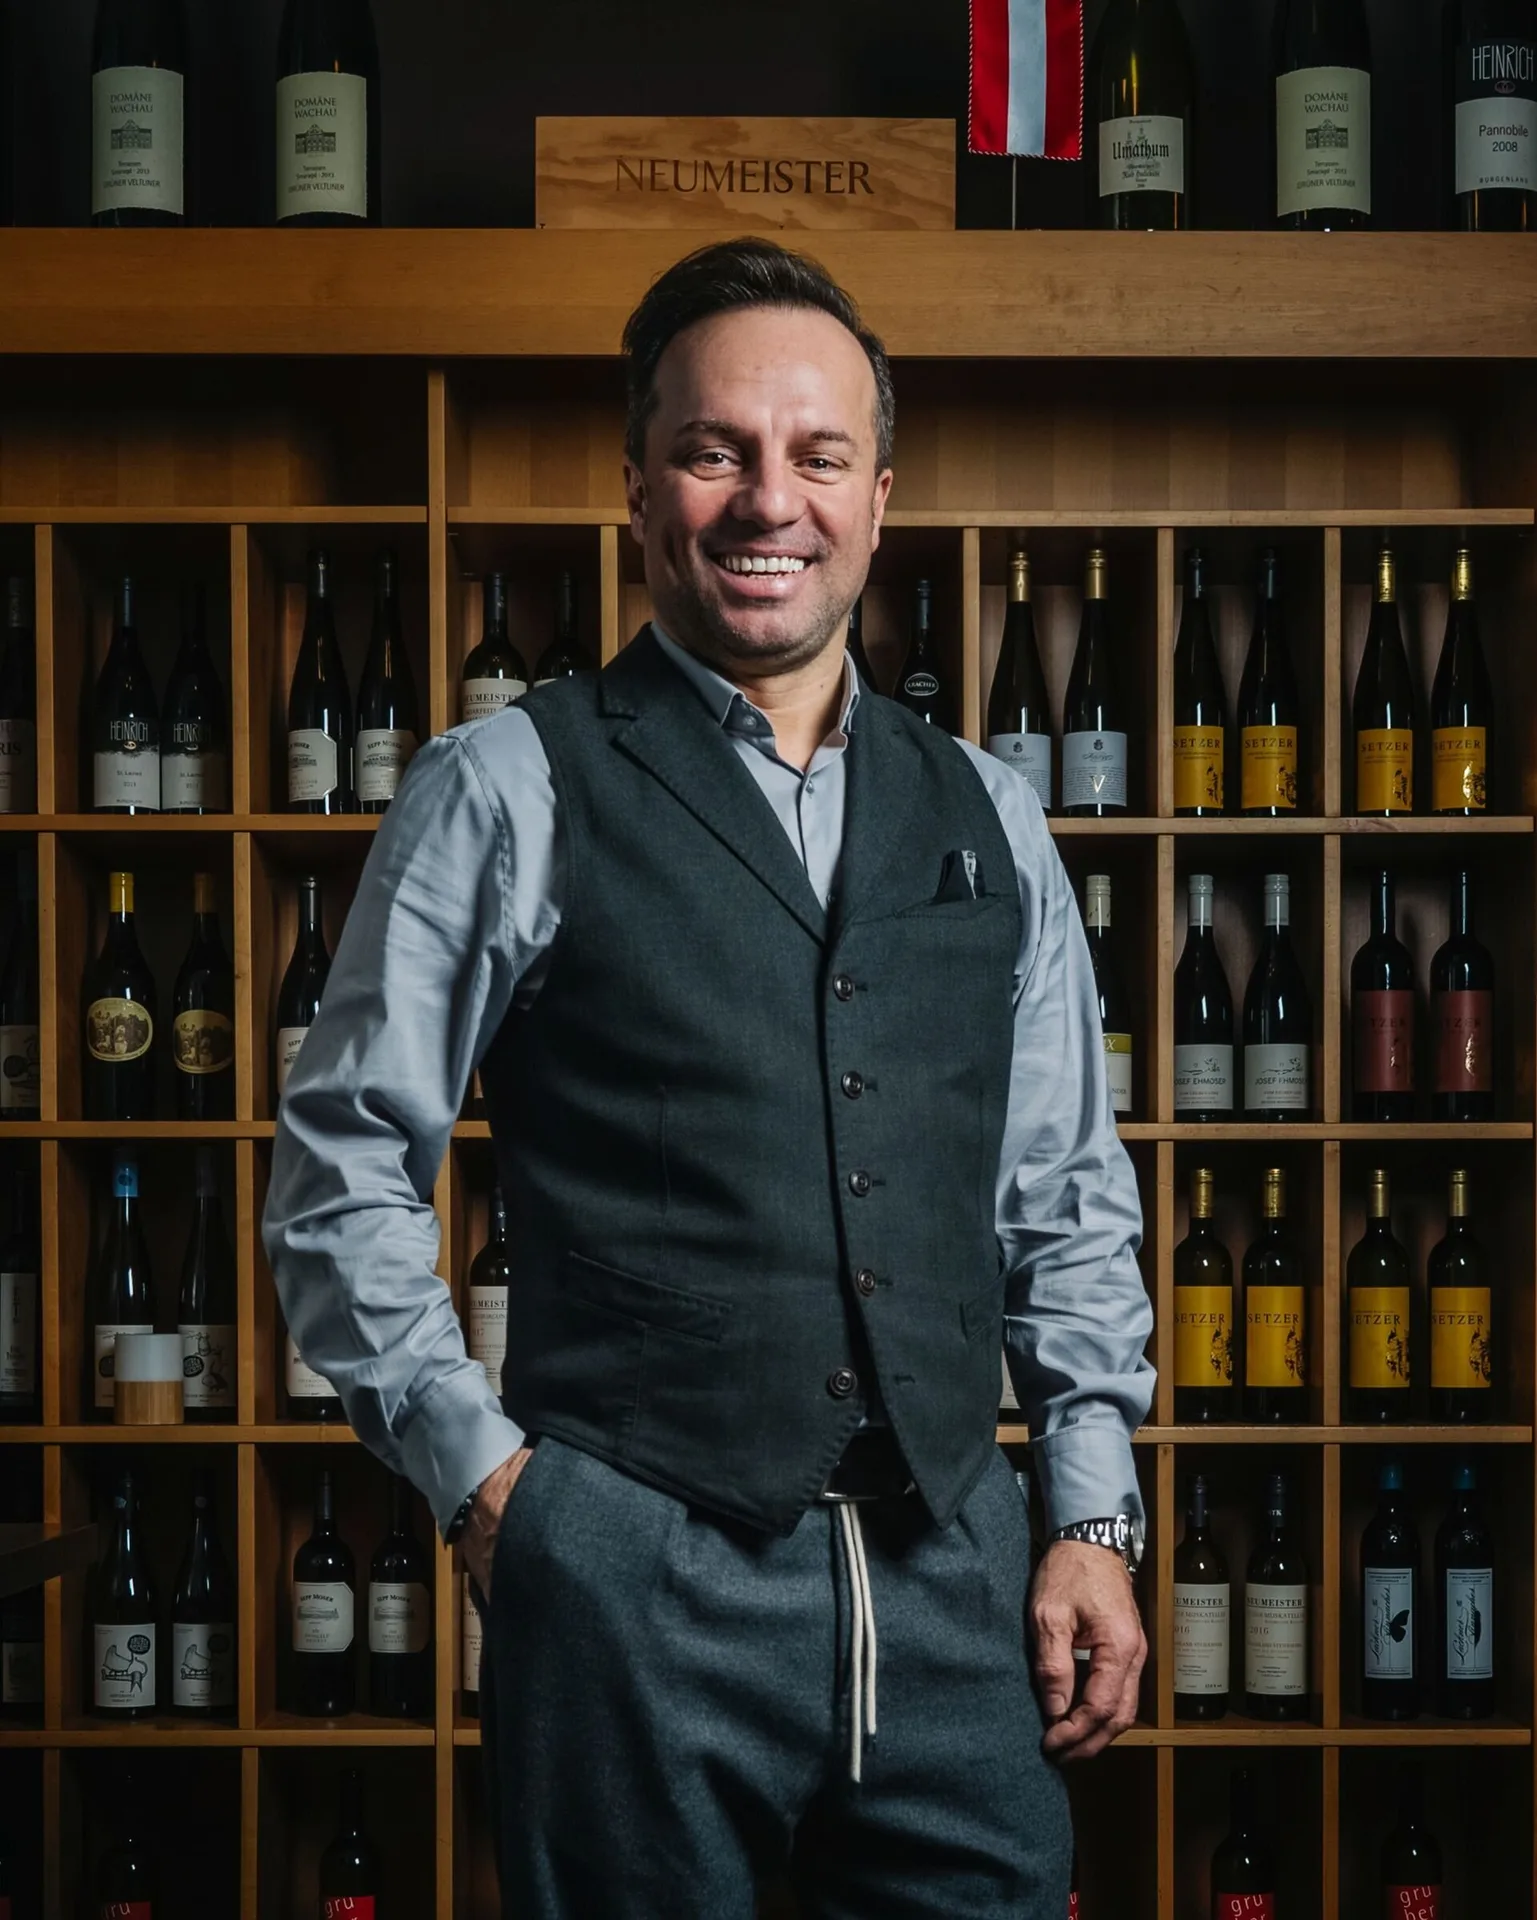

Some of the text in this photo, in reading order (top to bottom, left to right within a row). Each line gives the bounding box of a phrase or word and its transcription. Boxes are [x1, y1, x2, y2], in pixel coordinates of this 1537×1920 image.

[1472, 45, 1534, 81] HEINRICH
[110, 91, 153, 103] DOMÄNE
[294, 95, 337, 108] DOMÄNE
[1304, 91, 1349, 103] DOMÄNE
[110, 103, 154, 114] WACHAU
[294, 108, 337, 119] WACHAU
[1304, 103, 1349, 113] WACHAU
[1478, 124, 1529, 137] Pannobile
[1112, 139, 1169, 160] Umathum
[1491, 141, 1518, 152] 2008
[615, 158, 875, 195] NEUMEISTER
[1479, 175, 1528, 184] BURGENLAND
[109, 720, 149, 742] HEINRICH
[1173, 738, 1220, 749] SETZER
[1244, 737, 1293, 749] SETZER
[1361, 741, 1409, 752] SETZER
[1192, 1077, 1226, 1085] EHMOSER
[1255, 1077, 1276, 1085] JOSEF
[1173, 1313, 1225, 1323] SETZER
[1247, 1313, 1299, 1324] SETZER
[1433, 1314, 1483, 1325] SETZER
[313, 1594, 334, 1603] MOSER
[389, 1594, 410, 1603] MOSER
[1174, 1625, 1190, 1634] 016
[1249, 1626, 1269, 1635] 2016
[1400, 1885, 1432, 1908] gru
[325, 1896, 354, 1919] gru
[1230, 1894, 1264, 1917] gru
